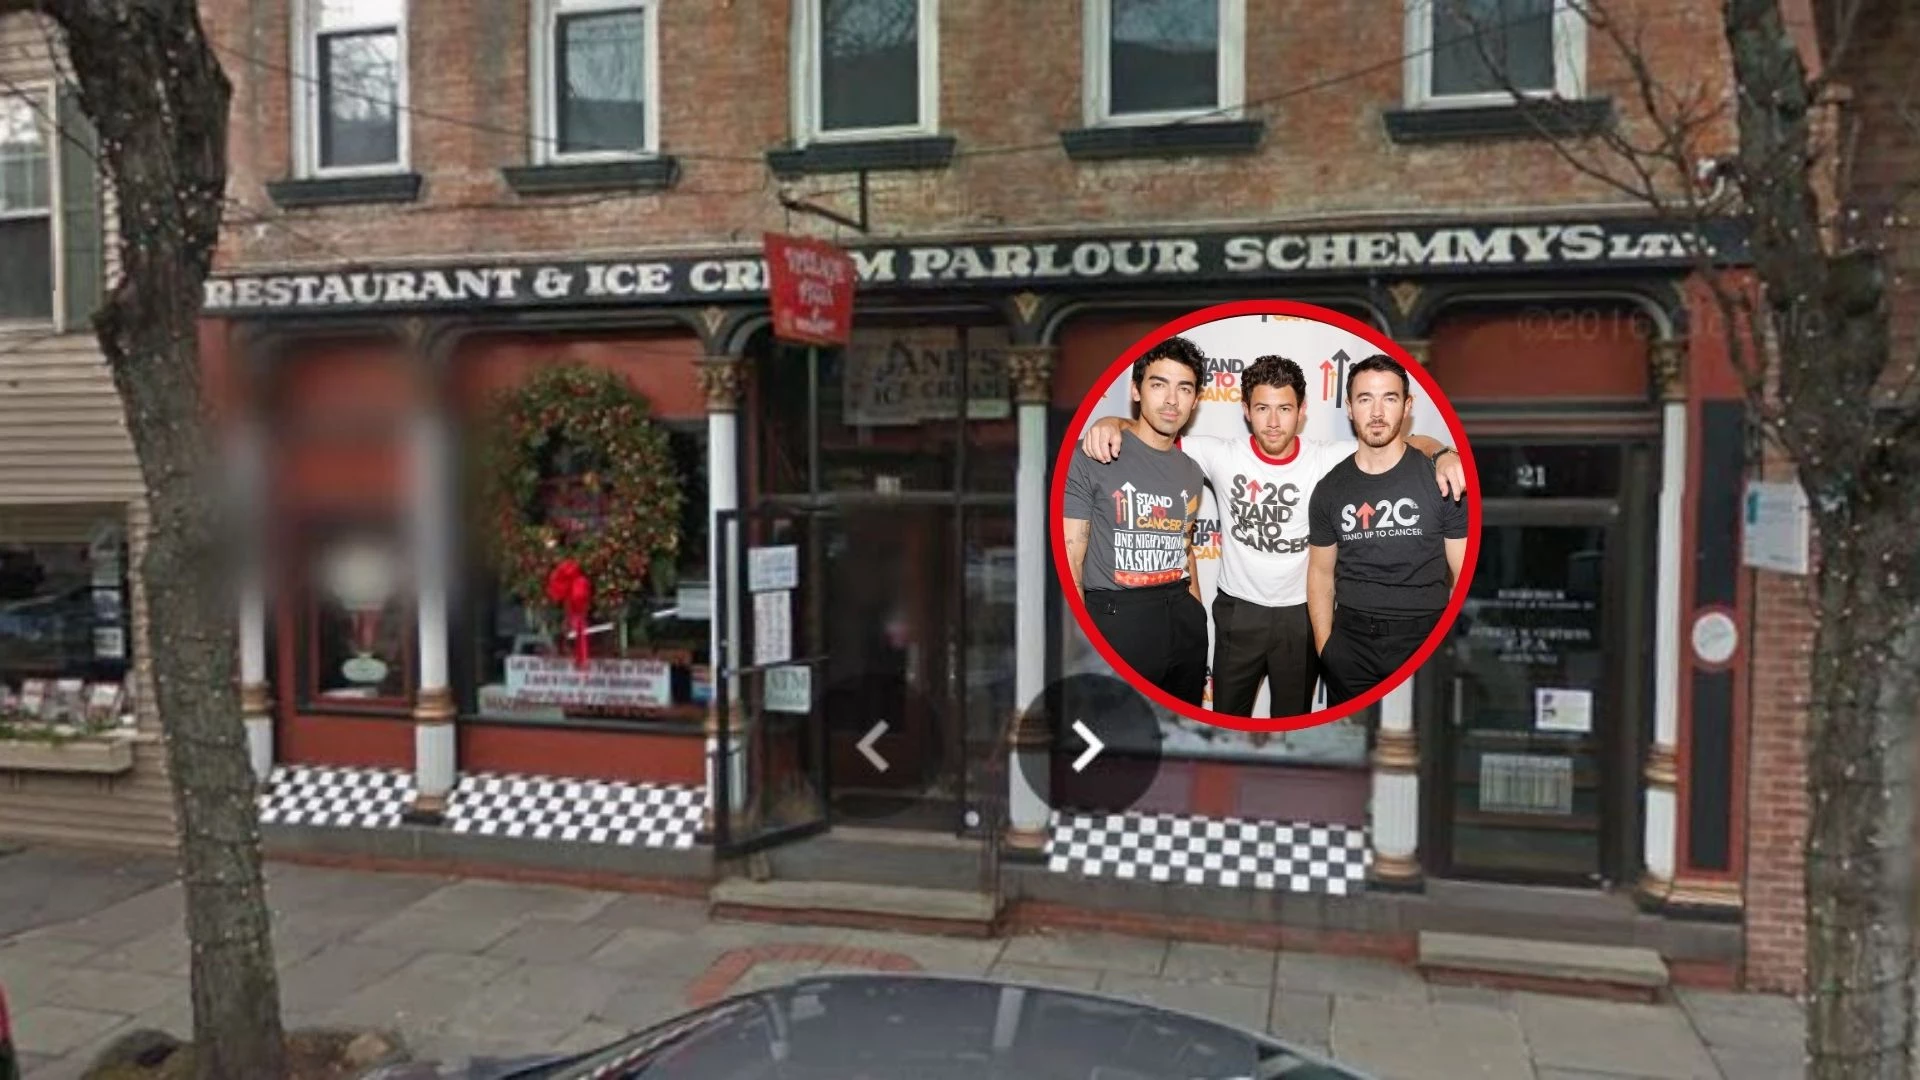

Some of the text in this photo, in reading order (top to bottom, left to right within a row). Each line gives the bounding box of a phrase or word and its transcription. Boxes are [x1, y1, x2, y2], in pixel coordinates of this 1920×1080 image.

[203, 267, 522, 309] RESTAURANT
[533, 266, 573, 299] &
[585, 263, 672, 296] ICE
[689, 250, 896, 293] CRM
[909, 239, 1200, 280] PARLOUR
[1224, 225, 1605, 271] SCHEMMYS
[1202, 358, 1244, 373] TAND
[1214, 372, 1235, 387] TO
[1517, 464, 1546, 487] 21
[1136, 493, 1173, 508] STAND
[1137, 503, 1152, 517] UP
[1136, 516, 1182, 531] CANCER
[1114, 532, 1134, 549] ONE
[1135, 533, 1161, 549] NIGHT
[1364, 531, 1374, 539] UP
[1376, 530, 1387, 538] TO
[1388, 528, 1423, 537] CANCER
